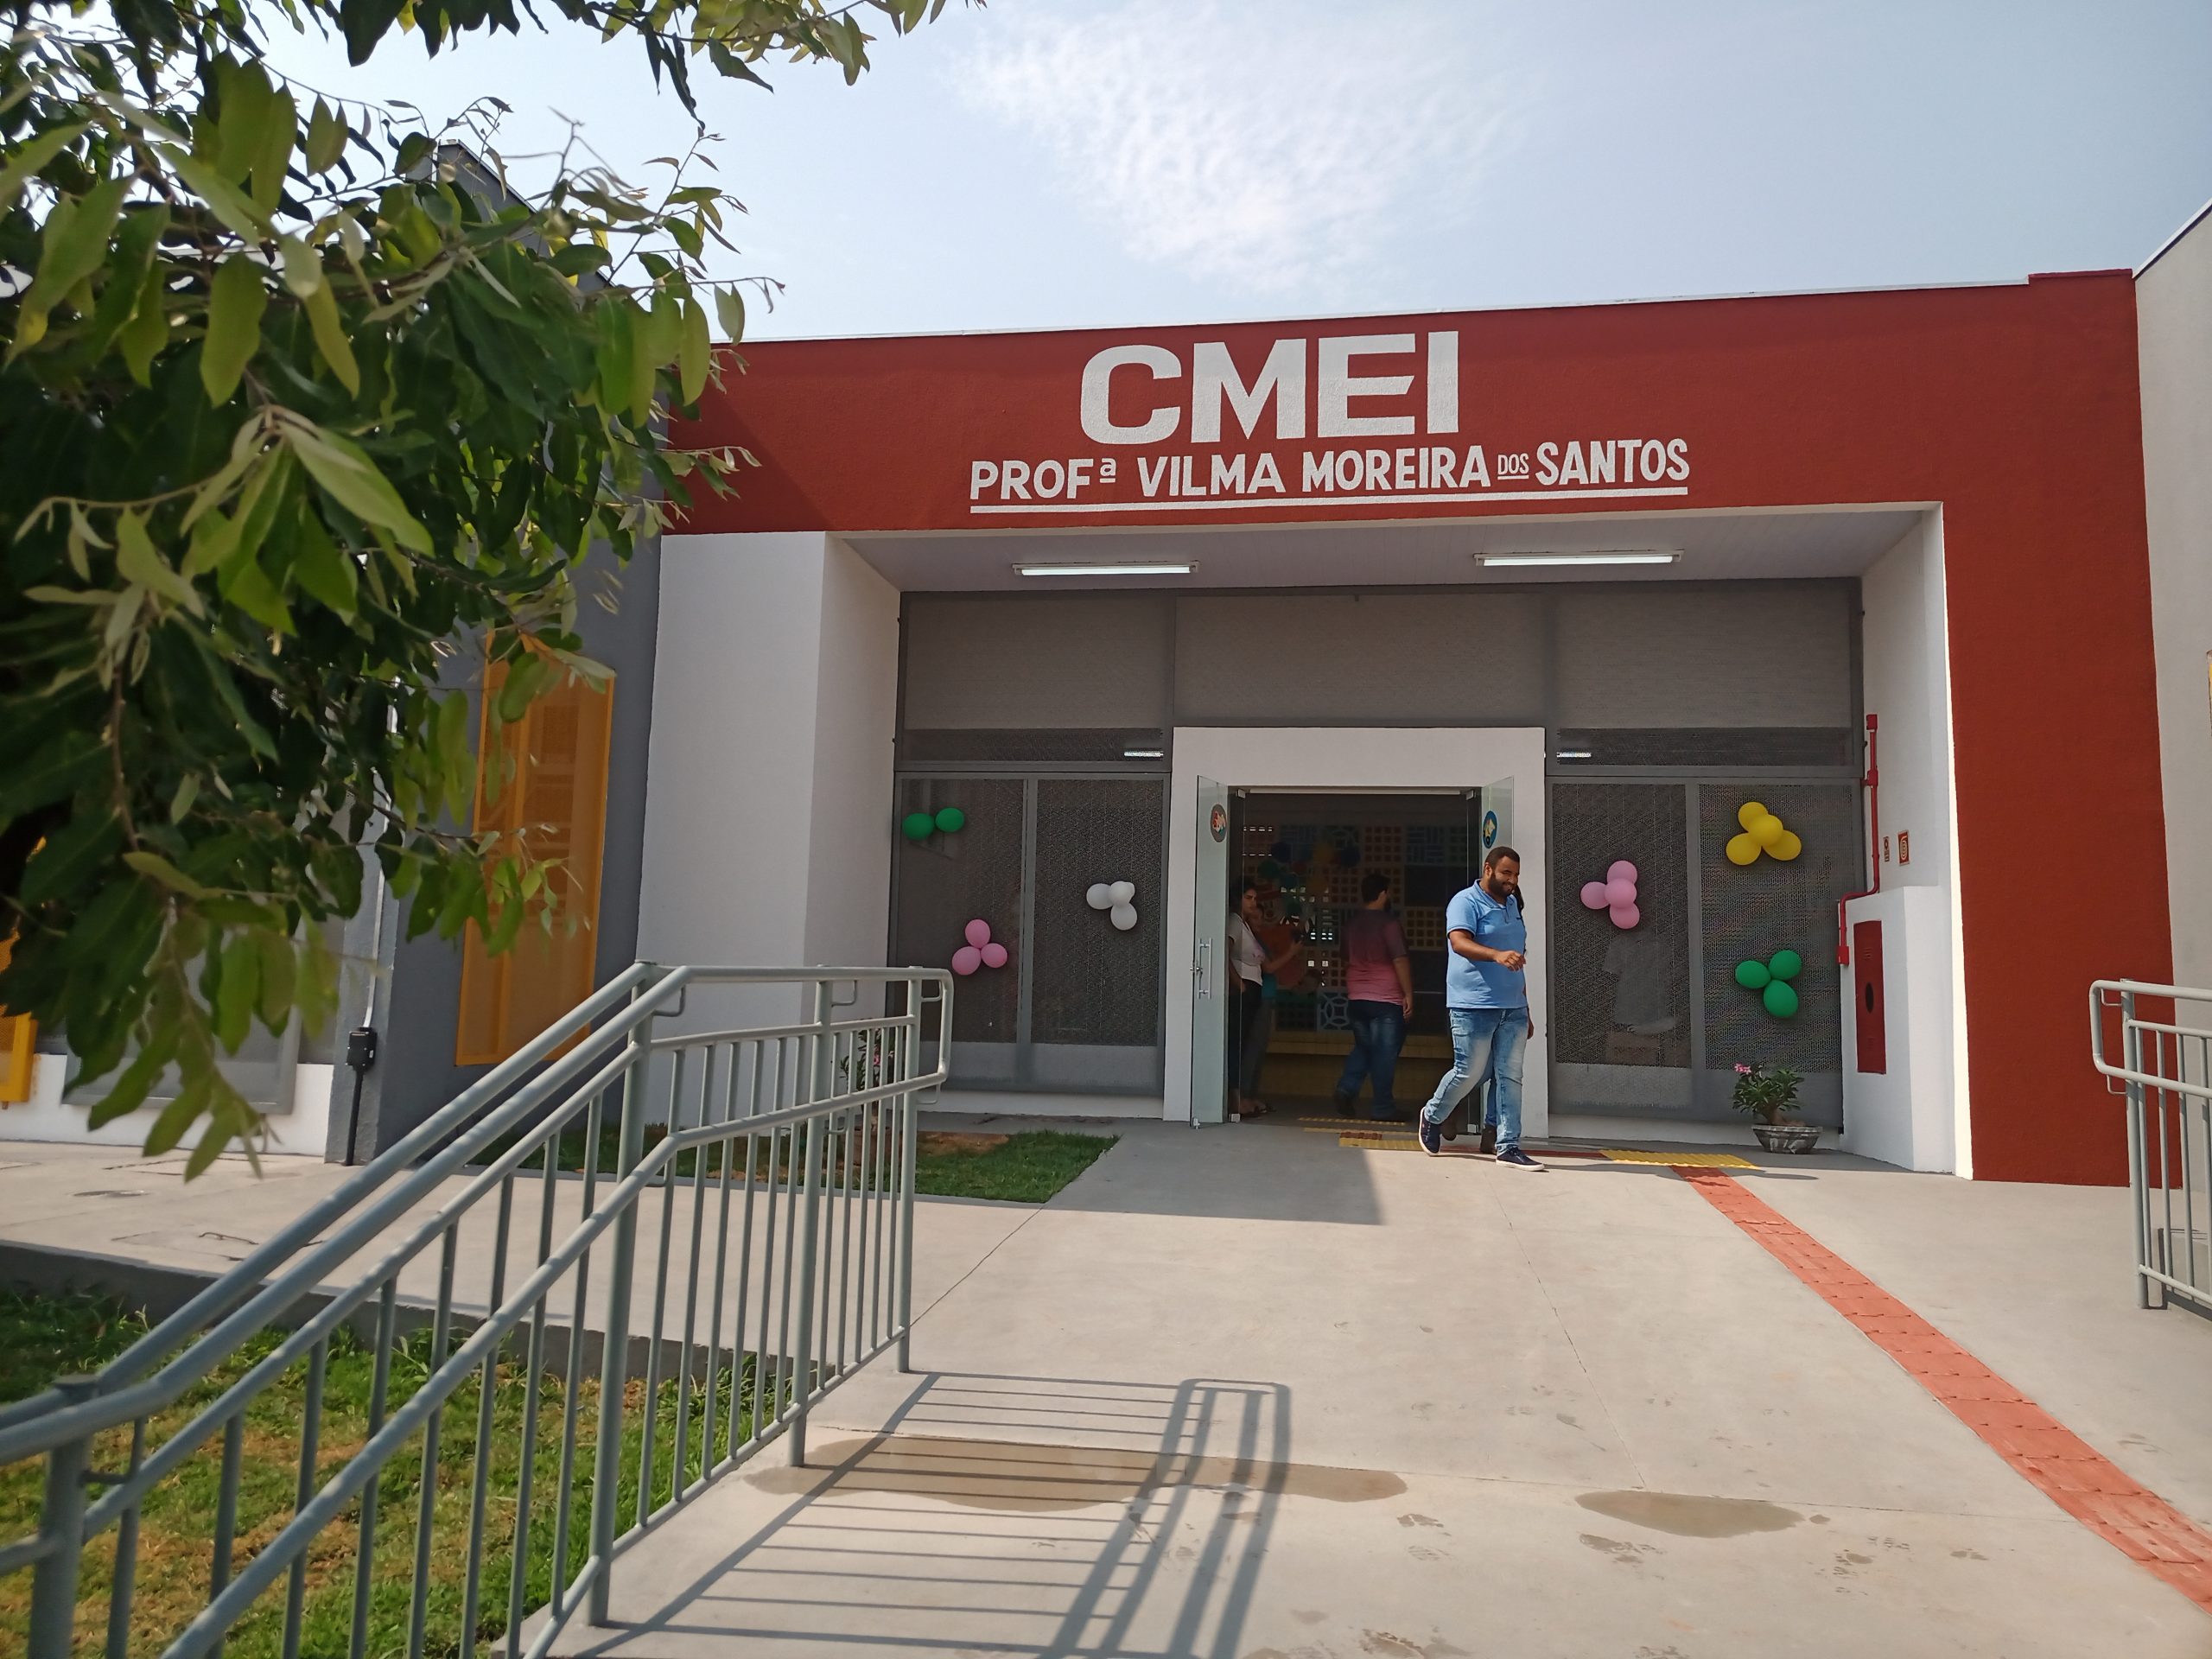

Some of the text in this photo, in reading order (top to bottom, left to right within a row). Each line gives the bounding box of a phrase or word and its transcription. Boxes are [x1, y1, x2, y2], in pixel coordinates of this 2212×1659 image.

[1081, 331, 1459, 445] CMEI
[1137, 453, 1286, 497] VILMA
[1302, 446, 1491, 493] MOREIRA
[1498, 453, 1529, 475] DOS
[1535, 439, 1690, 486] SANTOS
